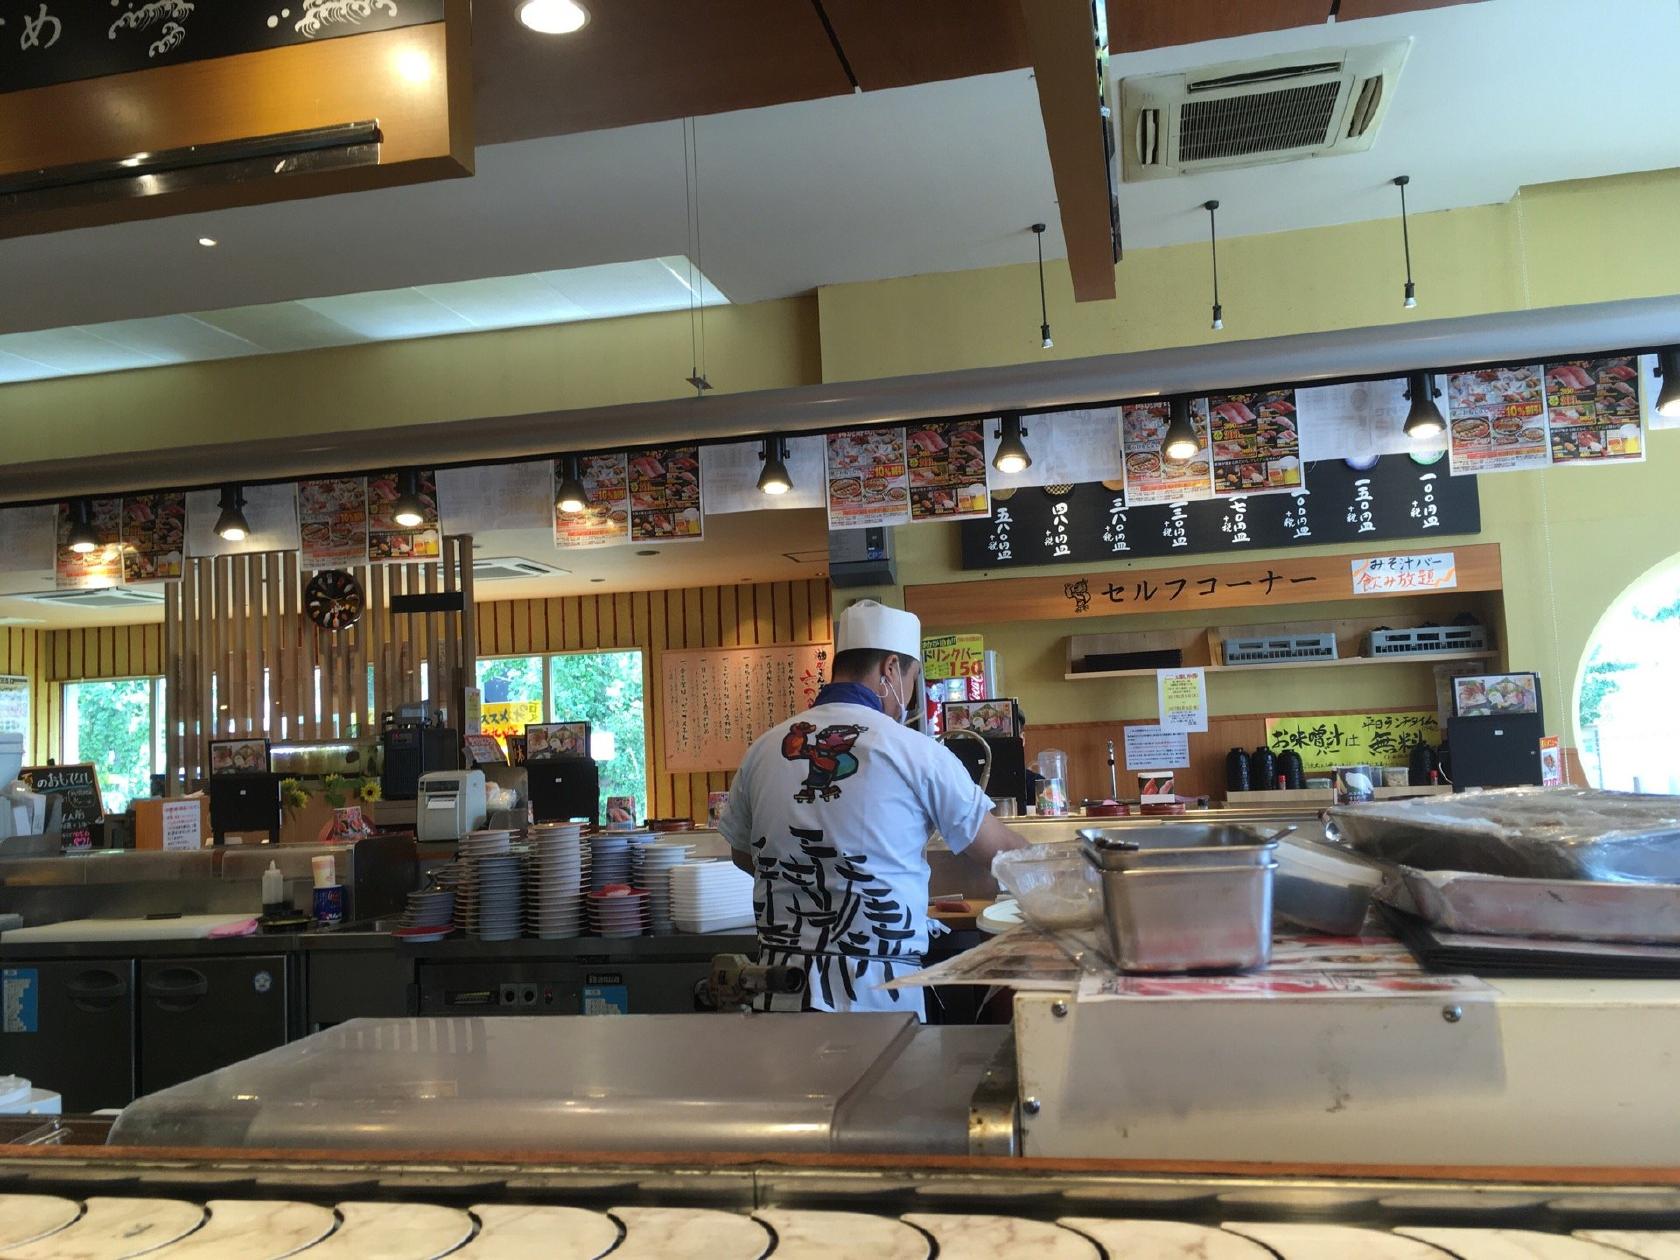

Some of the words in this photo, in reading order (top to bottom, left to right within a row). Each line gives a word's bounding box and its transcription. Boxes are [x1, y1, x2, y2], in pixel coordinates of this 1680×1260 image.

[1370, 557, 1442, 570] みそ汁バー
[1101, 569, 1317, 604] セルフコーナー
[1356, 568, 1436, 592] 飲み放題
[924, 647, 982, 662] ドリンクバー
